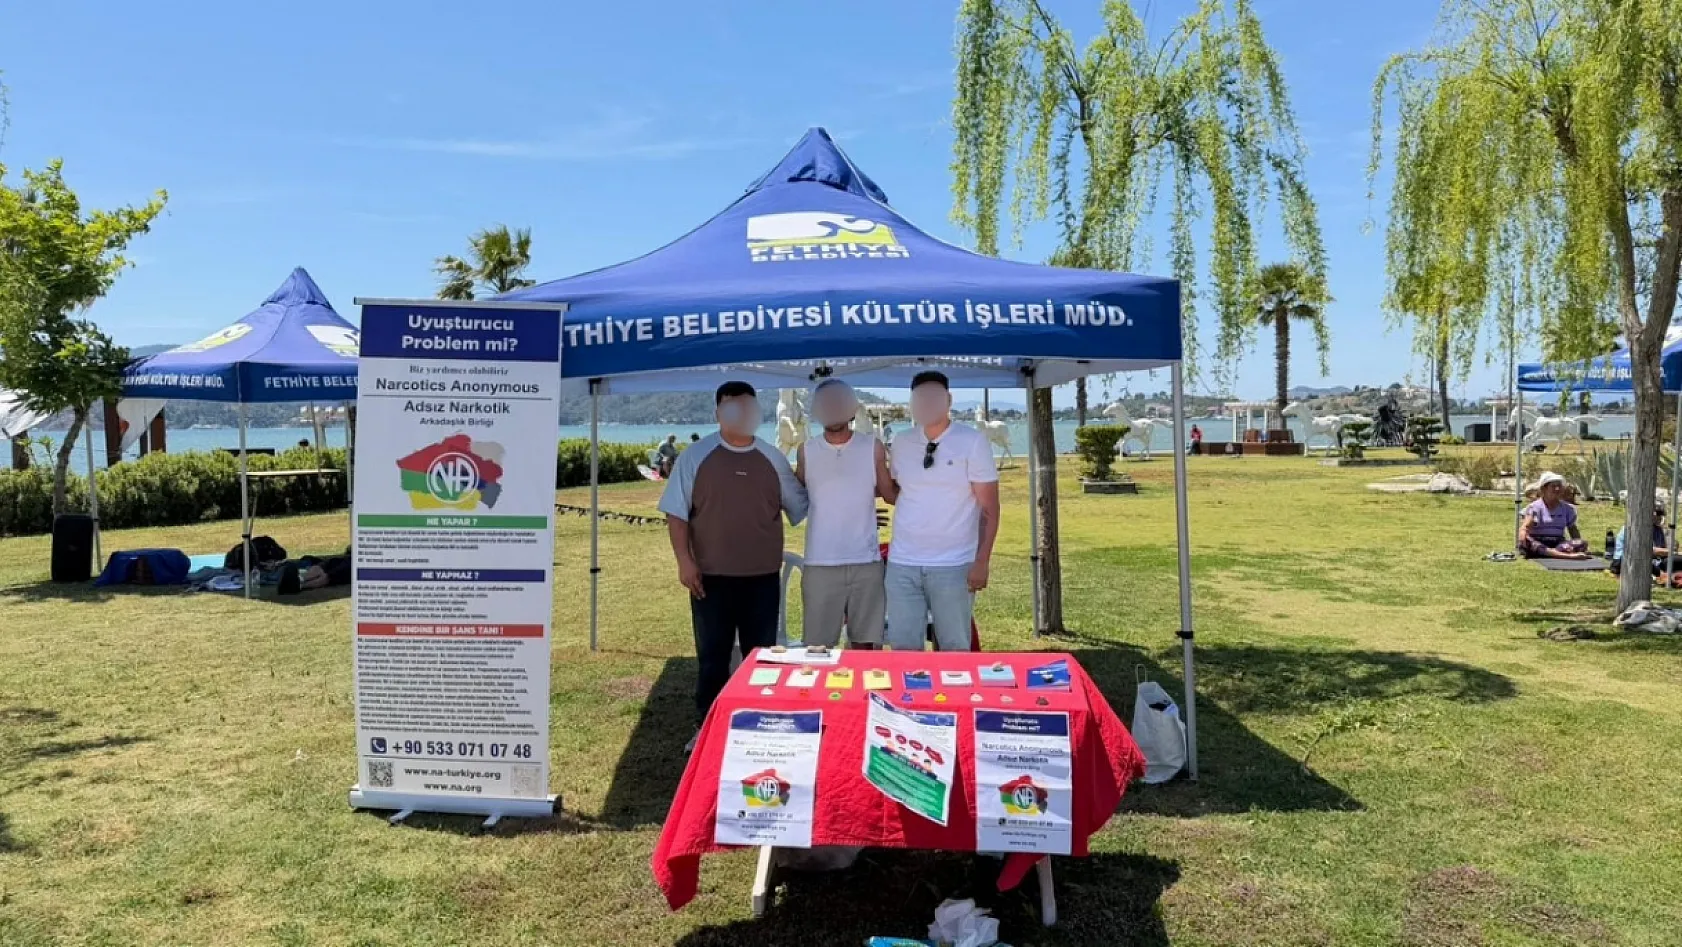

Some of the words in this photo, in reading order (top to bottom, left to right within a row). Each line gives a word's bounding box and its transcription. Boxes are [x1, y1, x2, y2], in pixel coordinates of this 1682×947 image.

[408, 314, 515, 331] Uyuşturucu
[663, 300, 831, 338] BELEDİYESİ
[841, 300, 957, 324] KÜLTÜR
[965, 298, 1055, 330] İŞLERİ
[1064, 300, 1134, 327] MÜD.
[401, 335, 480, 351] Problem
[485, 337, 519, 353] mi?
[409, 365, 424, 374] Biz
[263, 373, 321, 388] FETHİYE
[375, 378, 446, 391] Narcotics
[450, 380, 540, 396] Anonymous
[404, 400, 446, 413] Adsız
[449, 401, 511, 414] Narkotik
[392, 740, 422, 755] +90
[426, 740, 454, 756] 533
[458, 742, 484, 757] 071
[490, 743, 508, 758] 07
[513, 744, 532, 759] 48
[404, 767, 501, 781] www.na-turkiye.org
[423, 782, 483, 793] www.na.org
